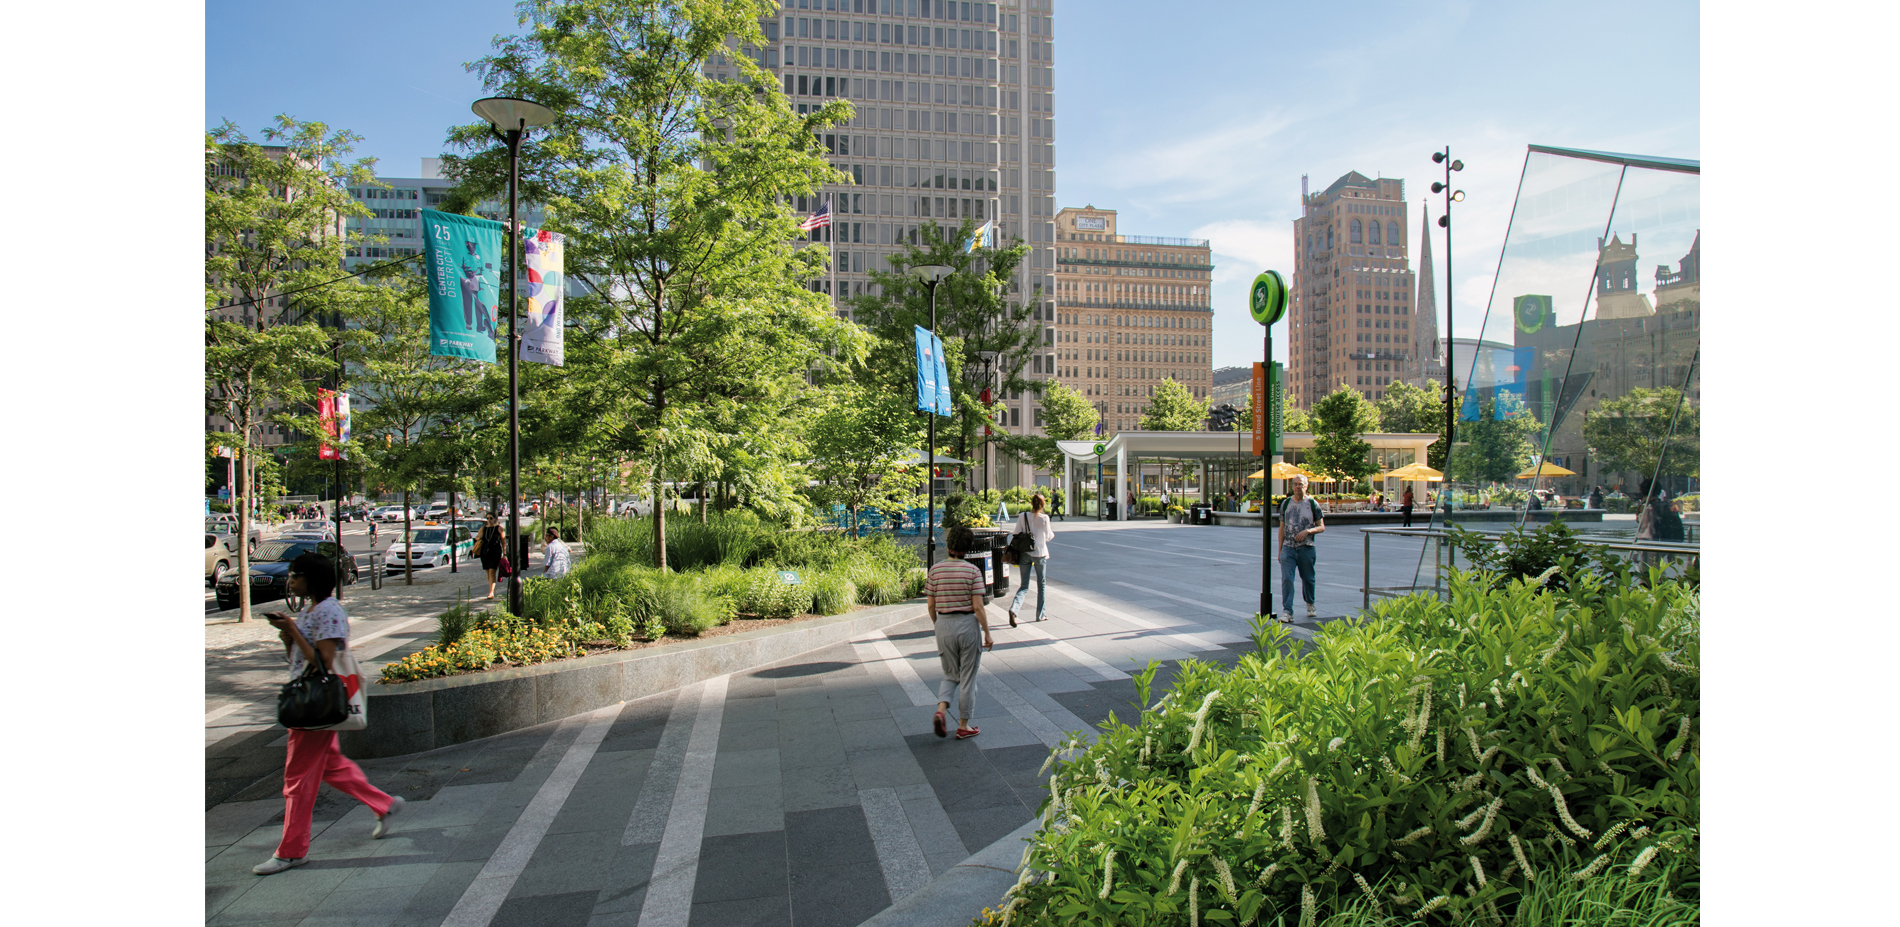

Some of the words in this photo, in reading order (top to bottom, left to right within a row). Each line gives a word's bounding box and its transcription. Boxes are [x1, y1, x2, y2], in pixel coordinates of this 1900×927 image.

[434, 224, 450, 241] 25
[435, 248, 444, 266] CITY
[436, 266, 447, 296] CENTER
[443, 249, 456, 297] DISTRICT
[448, 339, 474, 348] PARKWAY
[535, 346, 559, 355] PARKWAY
